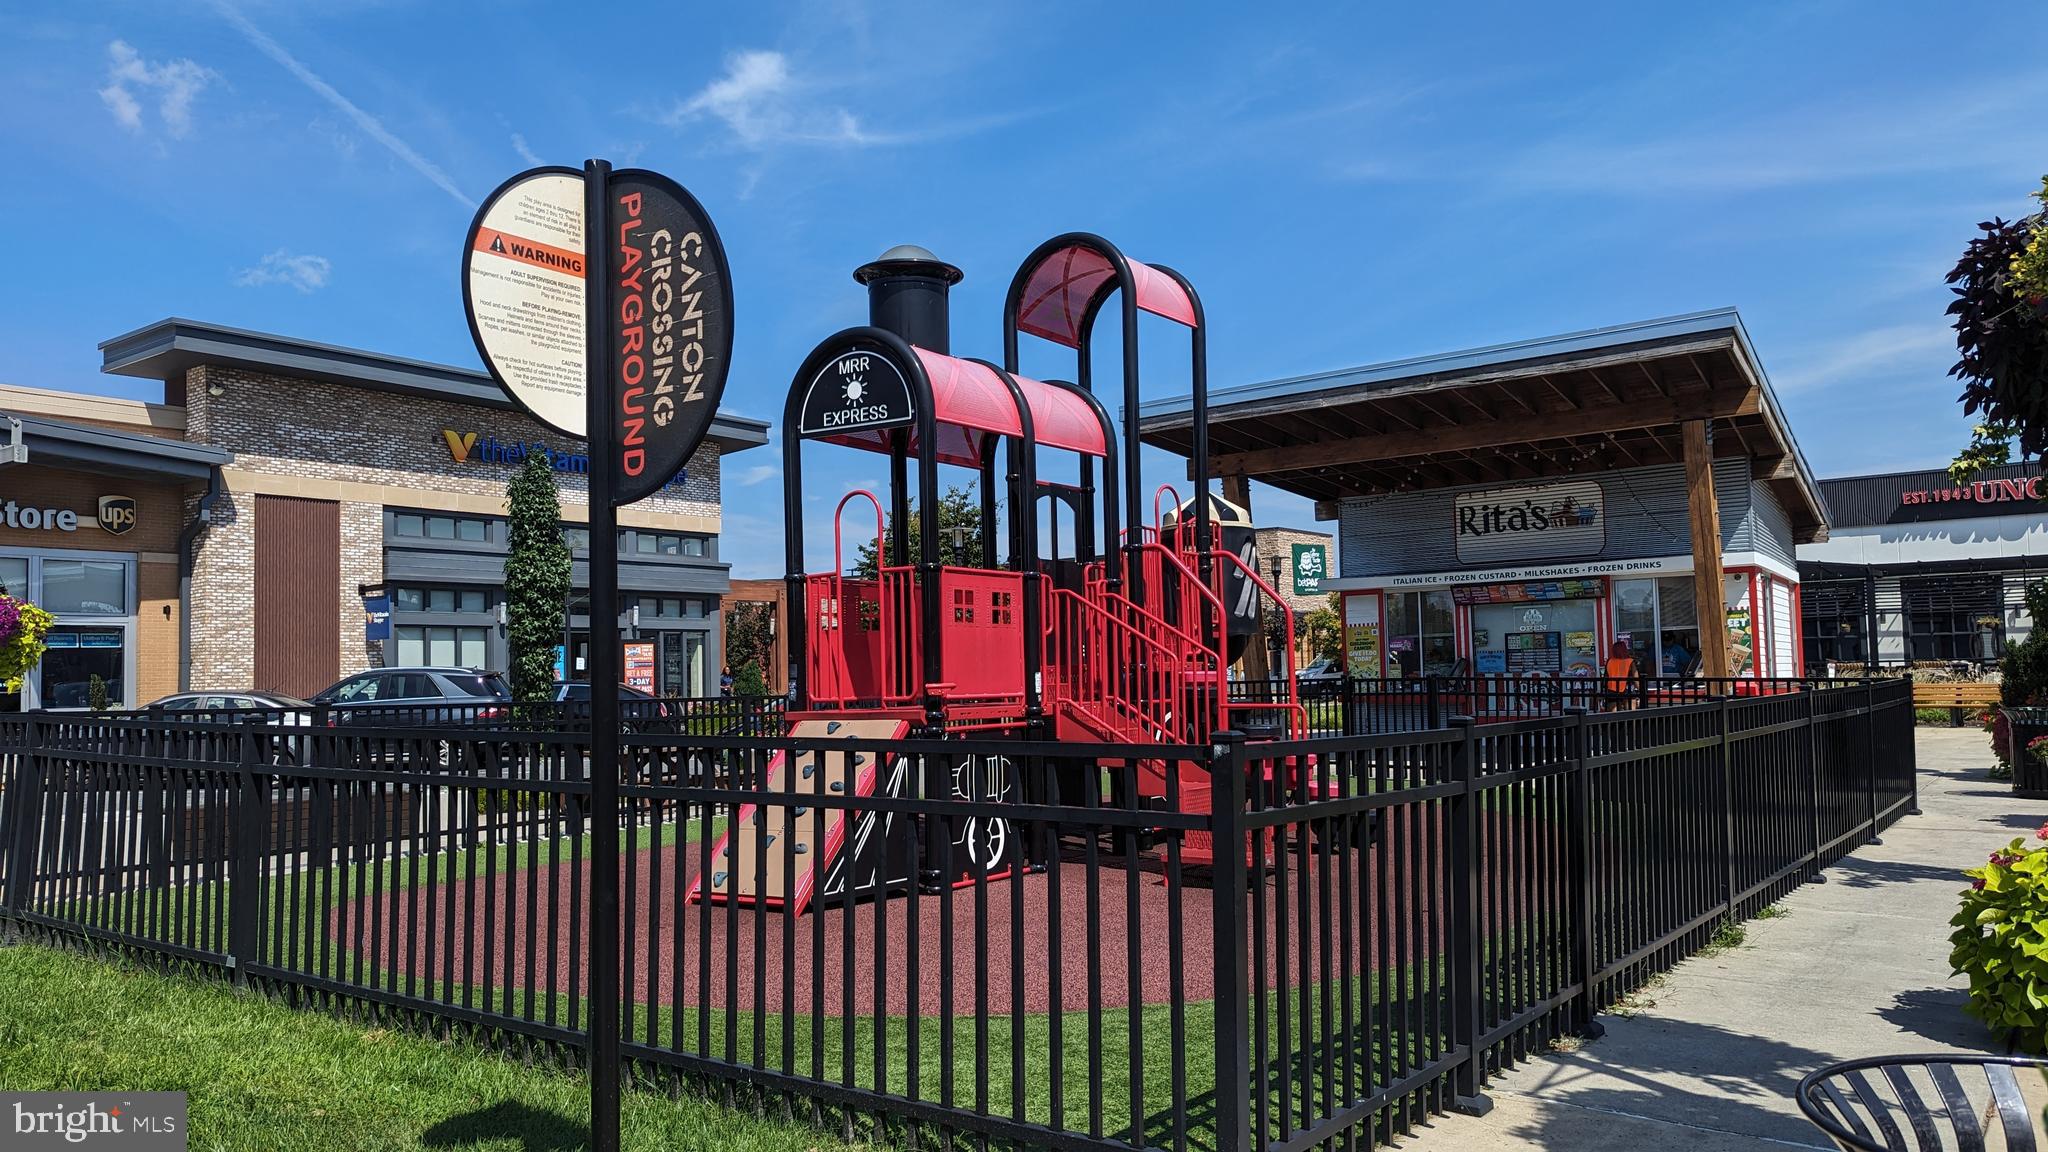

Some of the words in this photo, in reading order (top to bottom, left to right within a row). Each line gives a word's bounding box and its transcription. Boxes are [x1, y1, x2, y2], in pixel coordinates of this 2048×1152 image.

[530, 212, 545, 221] element
[557, 205, 574, 216] designed
[566, 215, 576, 224] There
[543, 224, 565, 234] responsible
[511, 243, 582, 272] WARNING
[511, 269, 525, 278] ADULT
[527, 273, 557, 286] SUPERVISION
[512, 278, 535, 288] responsible
[543, 286, 561, 294] accidents
[541, 291, 549, 299] Play
[480, 299, 491, 307] Hood
[513, 307, 536, 318] drawstrings
[522, 300, 540, 310] BEFORE
[479, 313, 495, 322] Scarves
[522, 324, 542, 333] connected
[544, 328, 558, 337] through
[680, 232, 704, 402] CANTON
[620, 192, 645, 477] PLAYGROUND
[651, 229, 674, 427] CROSSING
[538, 341, 560, 351] playground
[493, 353, 508, 362] Always
[554, 365, 566, 373] before
[513, 365, 532, 373] respectful
[538, 369, 551, 377] others
[838, 357, 870, 375] MRR
[544, 386, 565, 394] equipment
[823, 404, 888, 427] EXPRESS
[1933, 487, 1972, 503] 1943
[101, 506, 134, 529] ups
[1459, 499, 1550, 536] Rita's
[1393, 577, 1422, 585] ITALIAN
[1444, 574, 1477, 582] FROZEN
[1478, 571, 1517, 580] CUSTARD
[1524, 567, 1580, 577] MILKSHAKES
[1587, 564, 1624, 573] FROZEN
[1626, 561, 1662, 570] DRINKS
[1519, 624, 1547, 632] OPEN
[629, 678, 650, 686] 3-DAY
